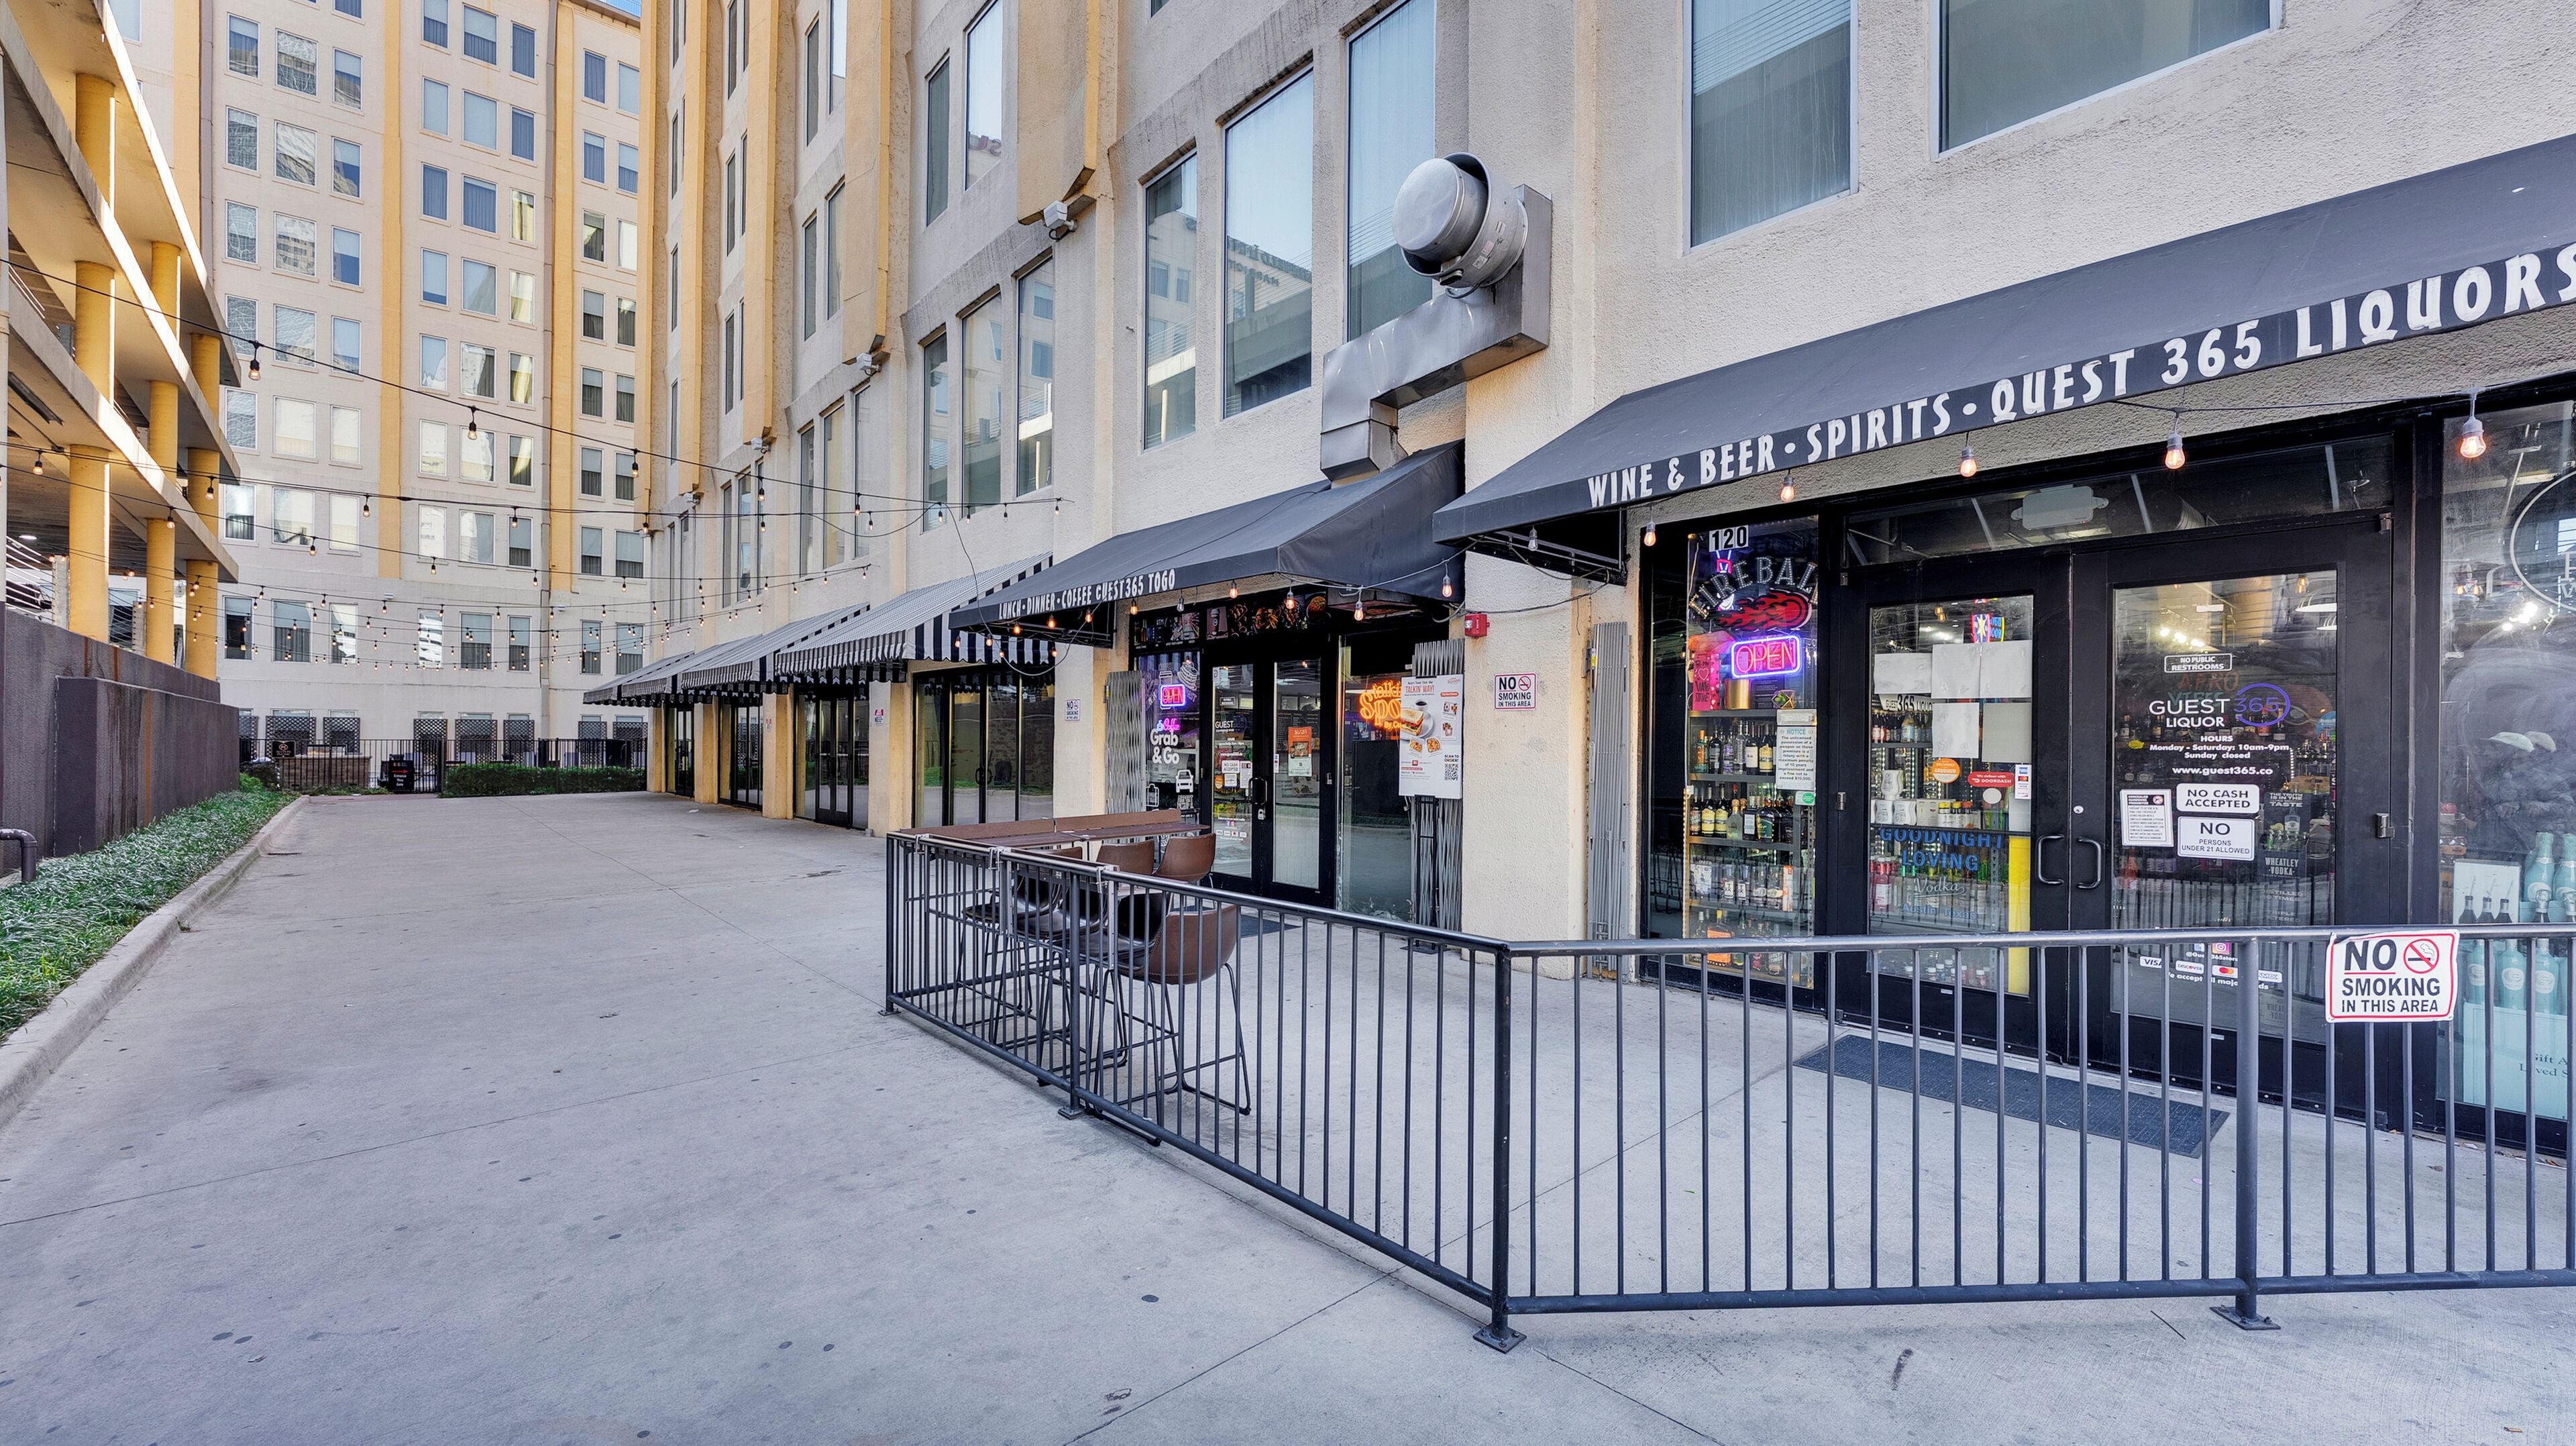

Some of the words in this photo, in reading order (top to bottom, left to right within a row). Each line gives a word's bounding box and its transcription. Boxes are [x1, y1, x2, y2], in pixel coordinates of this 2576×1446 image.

[1588, 463, 1653, 508] WINE
[1668, 457, 1684, 491] &
[1700, 434, 1776, 485] BEER
[1807, 392, 1951, 463] SPIRITS
[1991, 348, 2135, 424] QUEST
[2161, 319, 2262, 385] 365
[1712, 526, 1747, 550] 120
[999, 599, 1021, 620] LUNCH
[1026, 593, 1055, 614] DINNER
[1062, 585, 1092, 608] COFFEE
[1148, 569, 1175, 593] TOGO
[1689, 556, 1818, 619] FIREBAL
[1735, 639, 1796, 673] OPEN
[1499, 677, 1516, 690] NO
[1163, 687, 1183, 704] OPEN
[1499, 692, 1531, 700] SMOKING
[1886, 700, 1898, 709] GUEST
[1898, 694, 1914, 710] 365
[1916, 700, 1935, 712] LIQUO
[2149, 699, 2231, 715] GUEST
[2233, 698, 2280, 713] 365
[1163, 718, 1180, 732] Coffee
[2166, 716, 2224, 728] LIQUOR
[1150, 728, 1179, 746] Grab
[1163, 746, 1179, 764] Go
[2172, 767, 2273, 776] www.guest365.co
[2188, 789, 2208, 797] NO
[2214, 789, 2248, 798] CASH
[2185, 799, 2250, 808] ACCEPTED
[2200, 822, 2231, 835] NO
[1902, 849, 1978, 871] LOVING
[2265, 857, 2299, 867] WHEATLEY
[1914, 877, 1966, 893] Vodka
[1902, 903, 1937, 915] Austin
[1945, 908, 1977, 920] Texas
[2344, 939, 2397, 970] NO
[2177, 974, 2203, 982] accept
[2342, 978, 2440, 996] SMOKING
[2342, 1000, 2355, 1012] IN
[2361, 999, 2396, 1012] THIS
[2400, 999, 2438, 1012] AREA
[2519, 1063, 2557, 1076] Lved
